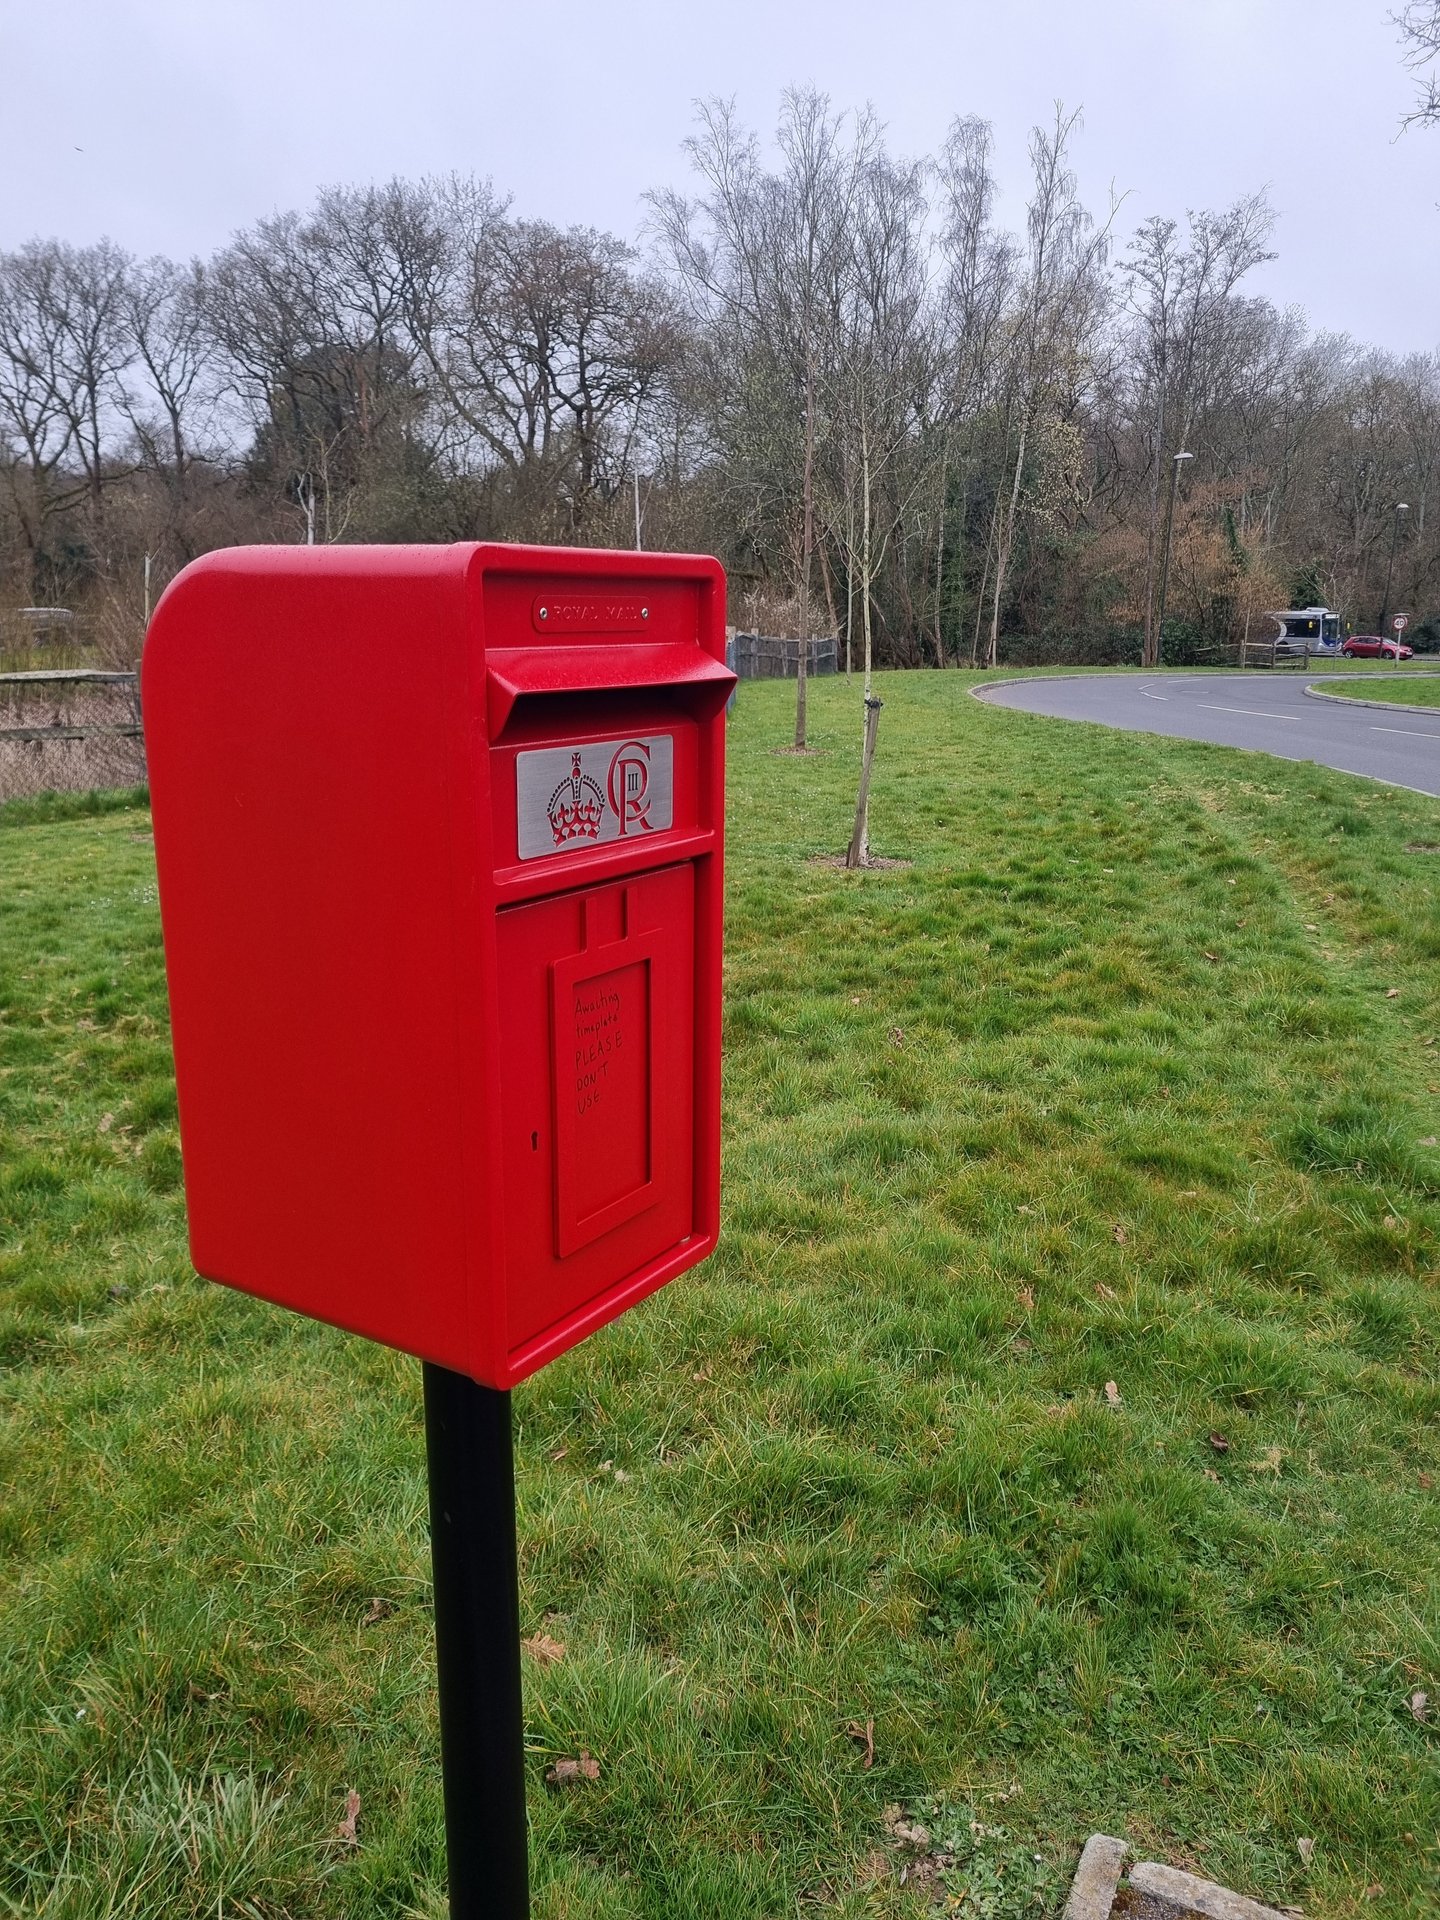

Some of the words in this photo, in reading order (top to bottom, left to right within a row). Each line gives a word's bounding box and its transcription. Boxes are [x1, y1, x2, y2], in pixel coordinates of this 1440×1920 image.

[553, 606, 598, 620] ROYAL
[604, 606, 638, 620] MAIL
[575, 988, 620, 1017] Awaiting
[575, 1030, 623, 1071] PLEASE
[576, 1061, 609, 1092] DON'T
[577, 1089, 600, 1115] USE
